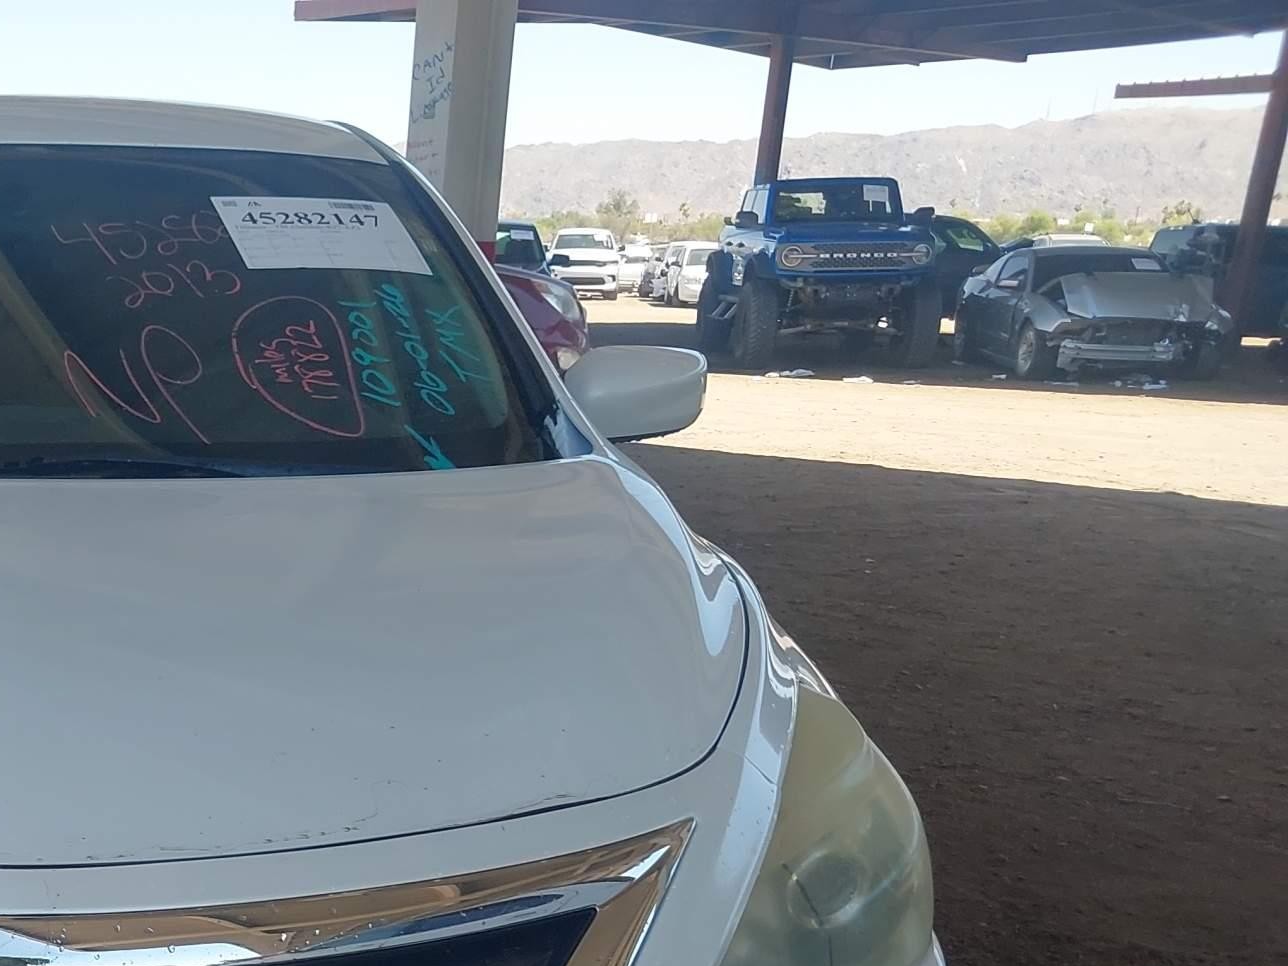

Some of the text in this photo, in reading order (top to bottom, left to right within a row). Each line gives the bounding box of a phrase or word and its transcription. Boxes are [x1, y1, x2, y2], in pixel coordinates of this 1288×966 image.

[241, 211, 378, 227] 45282147
[819, 251, 899, 259] BRONCO
[106, 259, 241, 309] 2013
[64, 324, 211, 445] NP
